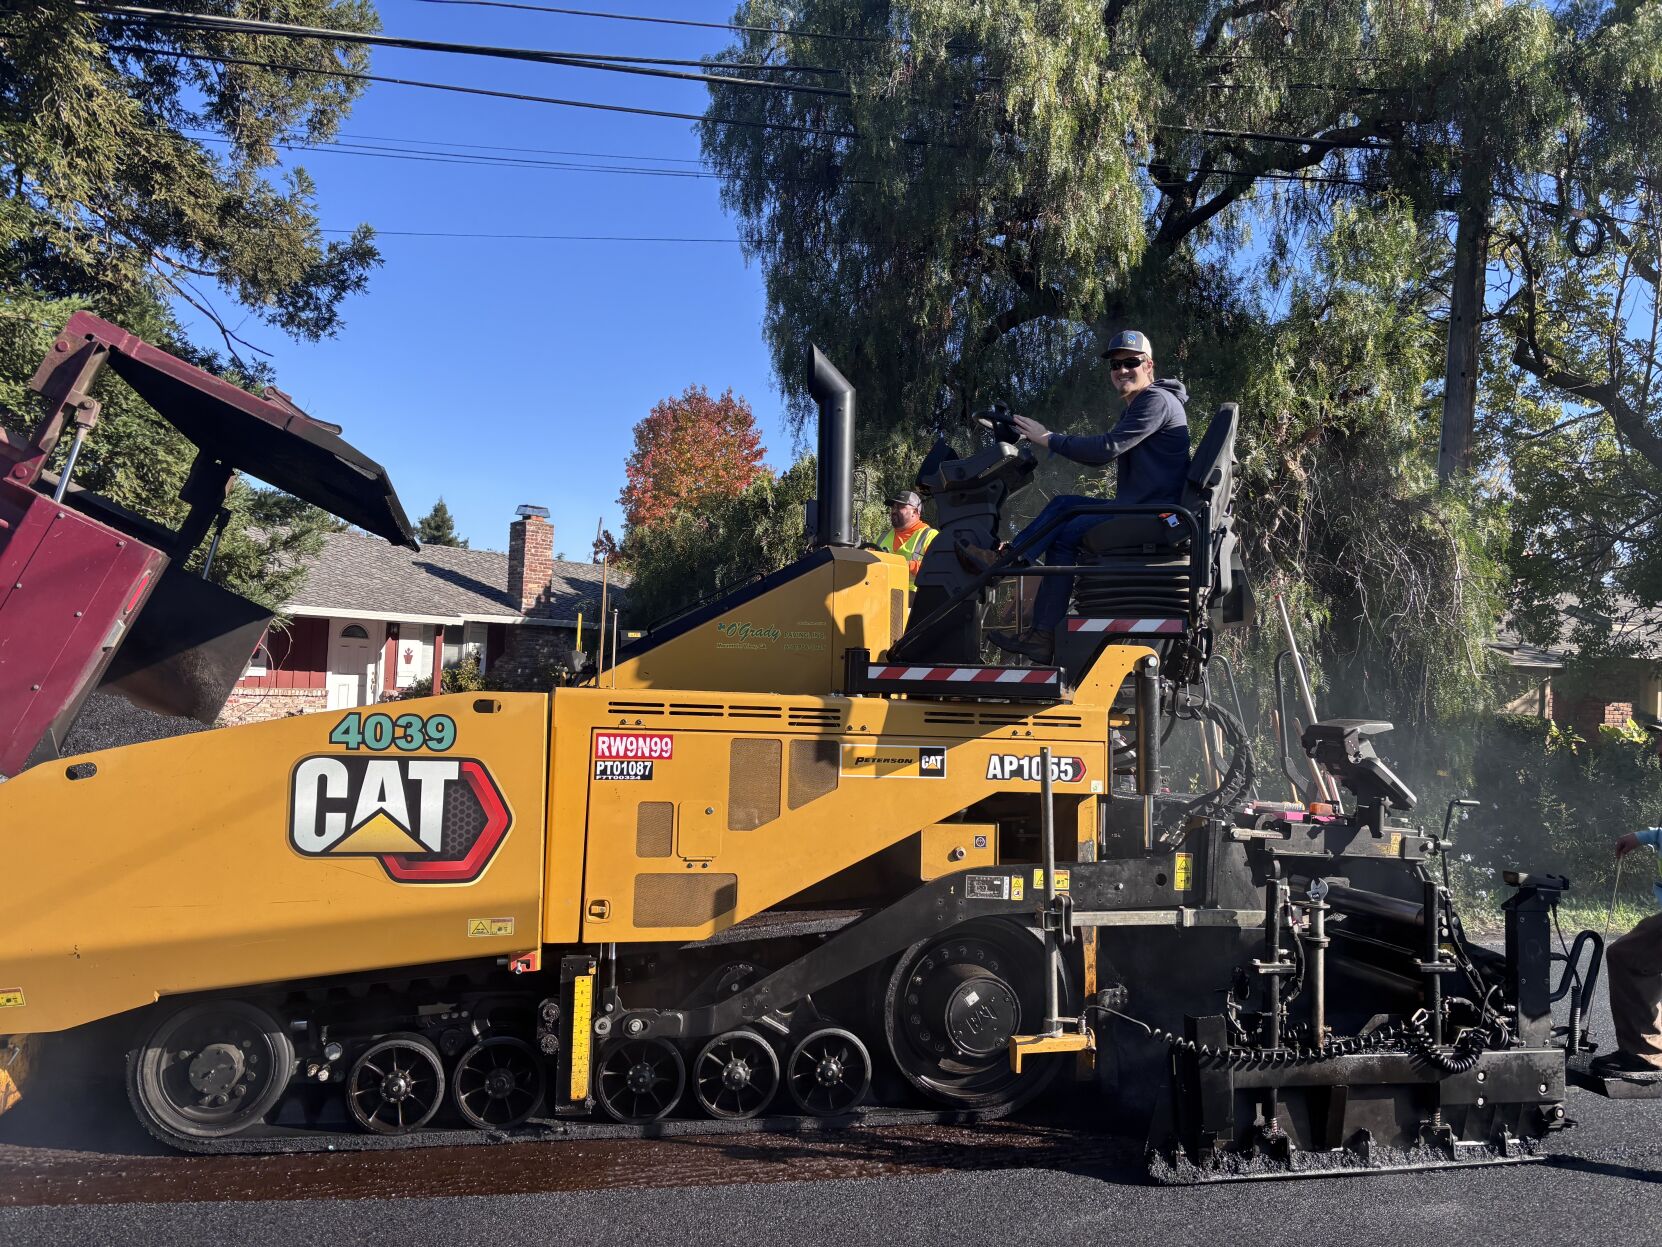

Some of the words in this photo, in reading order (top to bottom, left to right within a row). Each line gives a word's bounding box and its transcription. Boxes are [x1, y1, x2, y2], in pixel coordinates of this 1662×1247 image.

[726, 622, 781, 643] O'Grady
[329, 712, 457, 751] 4039
[597, 736, 672, 758] RW9N99
[596, 761, 652, 775] PT01087
[921, 755, 943, 770] CAT
[293, 757, 460, 852] CAT
